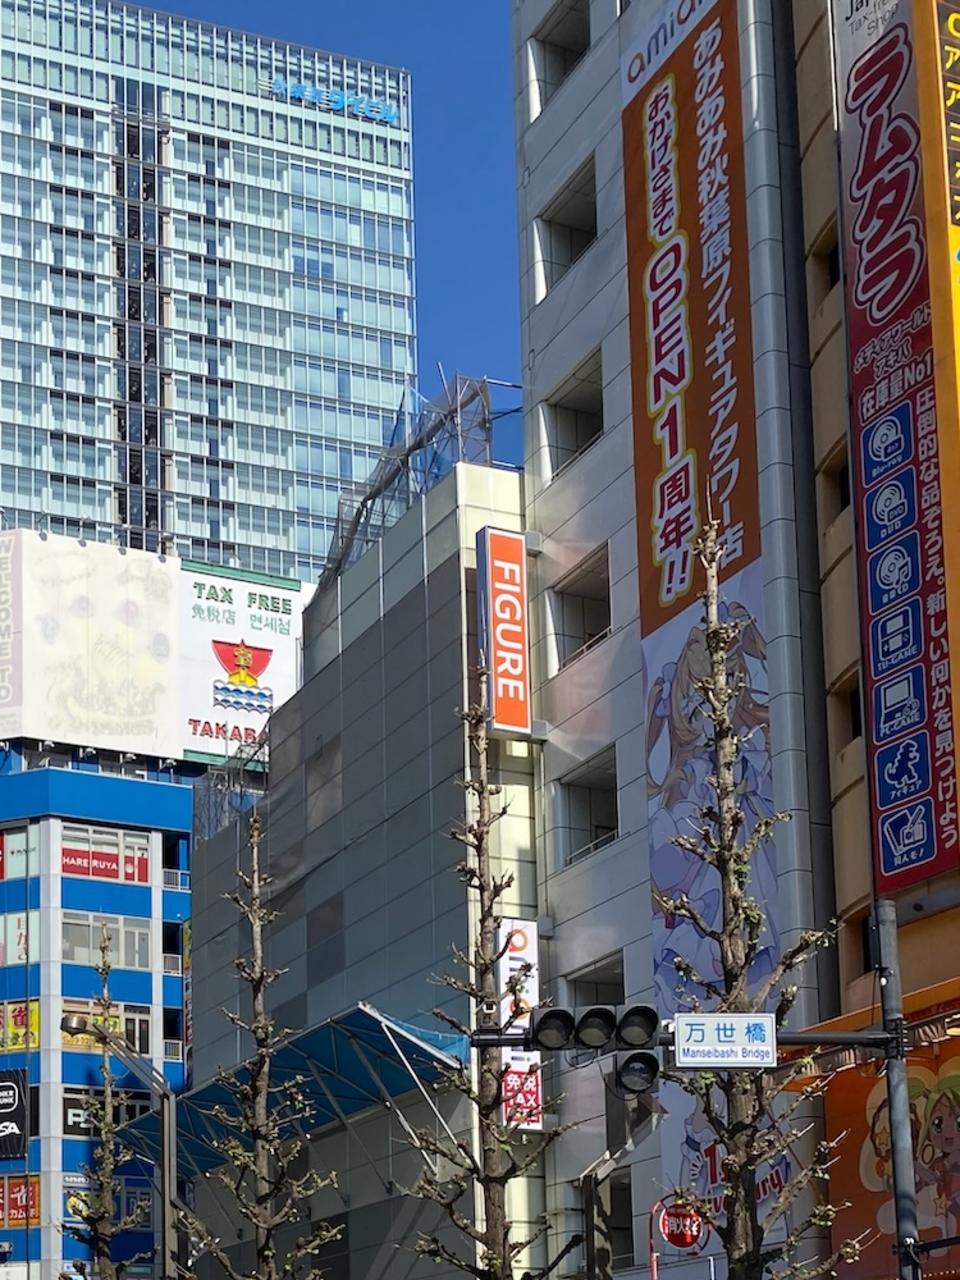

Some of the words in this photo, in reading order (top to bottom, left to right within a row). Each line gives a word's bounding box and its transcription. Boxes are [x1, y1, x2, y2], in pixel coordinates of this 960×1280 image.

[848, 34, 922, 319] ラムタラ
[193, 582, 234, 605] TAX
[247, 591, 293, 616] FREE
[493, 559, 524, 702] FIGURE
[685, 1022, 766, 1043] 万世橋
[682, 1047, 739, 1058] Manseibashi
[741, 1047, 771, 1061] Bridge
